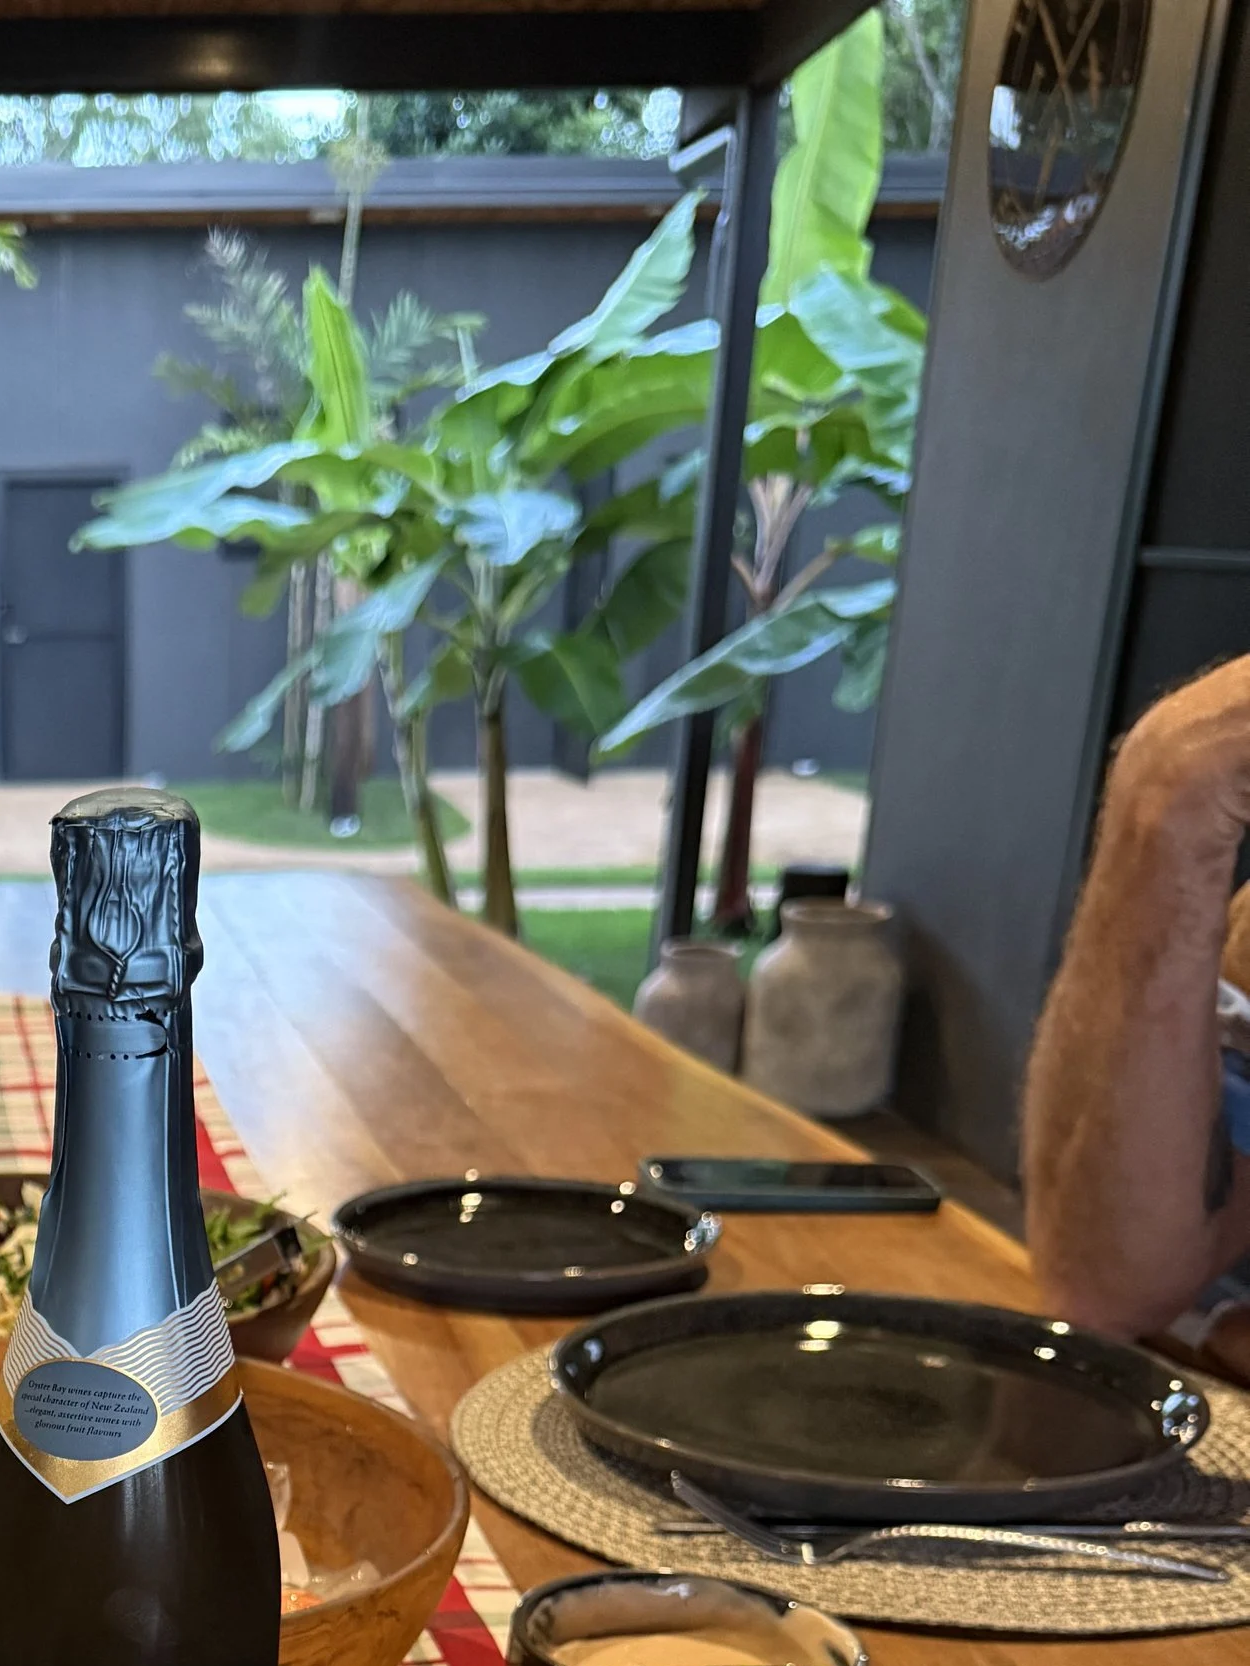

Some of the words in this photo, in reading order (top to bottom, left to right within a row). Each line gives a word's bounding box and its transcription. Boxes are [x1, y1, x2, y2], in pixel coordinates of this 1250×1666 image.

[28, 1380, 51, 1391] Oyster
[51, 1384, 66, 1395] Bay
[67, 1387, 92, 1396] wines
[93, 1390, 126, 1400] capture
[127, 1392, 142, 1402] the
[42, 1394, 79, 1407] character
[80, 1400, 90, 1411] of
[91, 1401, 112, 1411] New
[113, 1403, 150, 1415] Zealand
[34, 1419, 66, 1431] glorious
[65, 1423, 86, 1433] fruit
[86, 1425, 122, 1438] flavours
[57, 1411, 94, 1422] assertive
[94, 1416, 120, 1425] wines
[121, 1418, 142, 1427] with
